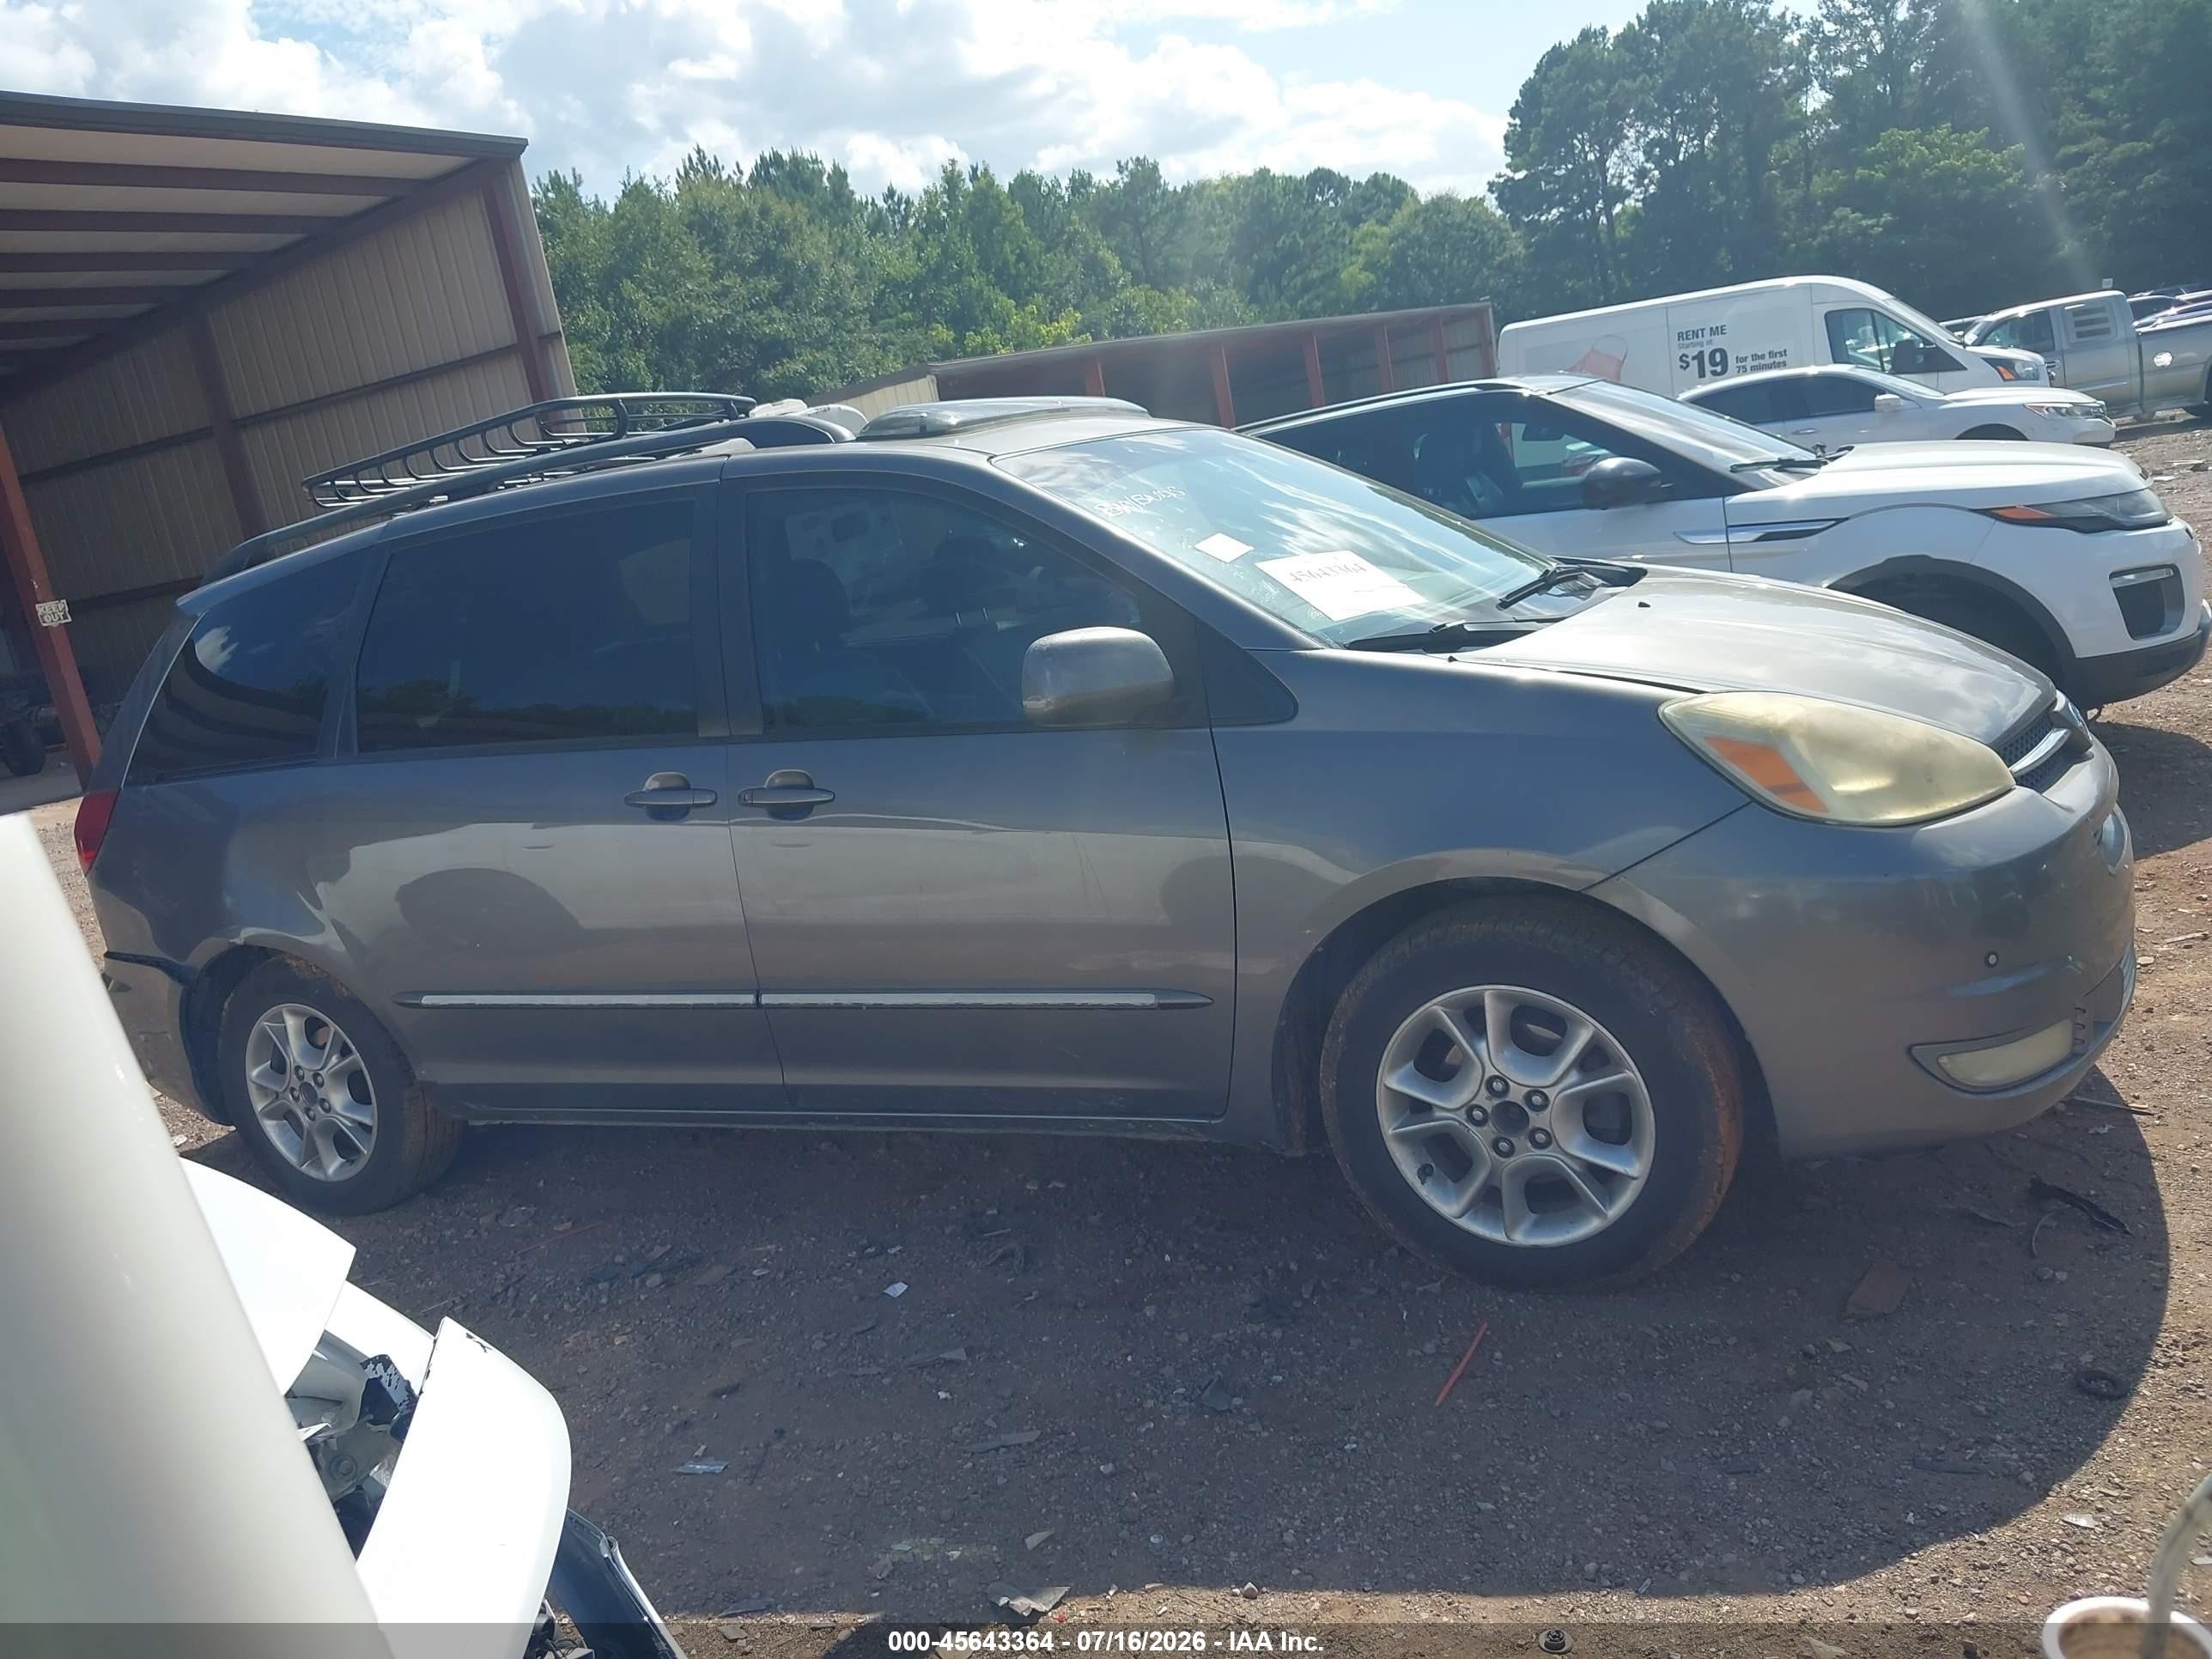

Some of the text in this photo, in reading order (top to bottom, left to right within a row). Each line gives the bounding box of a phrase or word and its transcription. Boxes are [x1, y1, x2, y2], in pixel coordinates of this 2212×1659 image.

[1677, 325, 1728, 342] RENT ME
[1677, 341, 1704, 349] Starting
[1735, 349, 1788, 364] for the first
[1679, 348, 1729, 379] $19
[1750, 361, 1787, 371] minutes
[39, 603, 64, 614] KEEP
[44, 611, 64, 623] OUT
